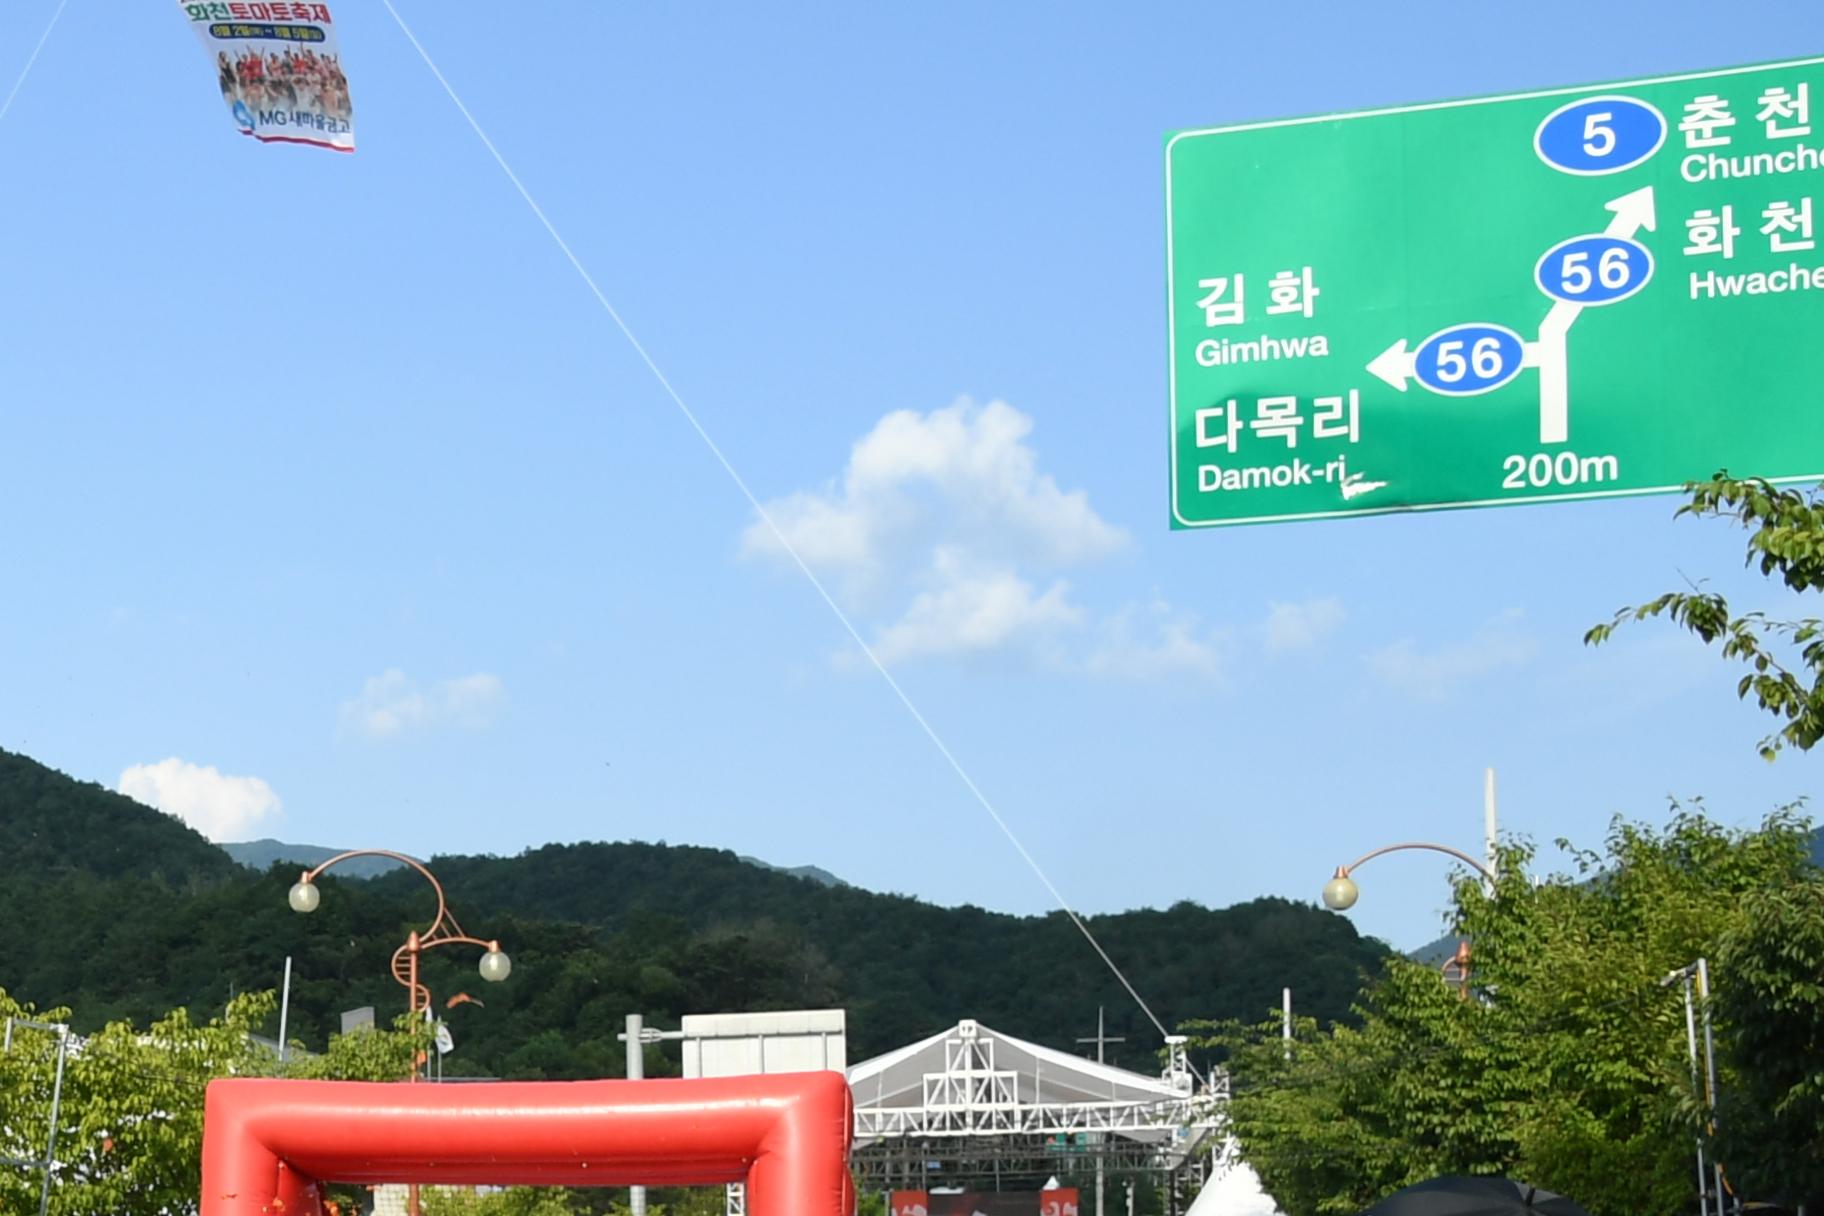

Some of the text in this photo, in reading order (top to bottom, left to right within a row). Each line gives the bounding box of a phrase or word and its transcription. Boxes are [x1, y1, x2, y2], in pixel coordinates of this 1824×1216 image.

[259, 110, 351, 134] MG 새마을금고
[1583, 112, 1615, 157] 5
[1681, 142, 1824, 184] Chunch
[1561, 248, 1630, 295] 56
[1195, 333, 1328, 367] Gimhwa
[1436, 337, 1503, 383] 56
[1195, 389, 1359, 454] 다목리
[1198, 455, 1346, 494] Damok-ri
[1502, 451, 1618, 488] 200m
